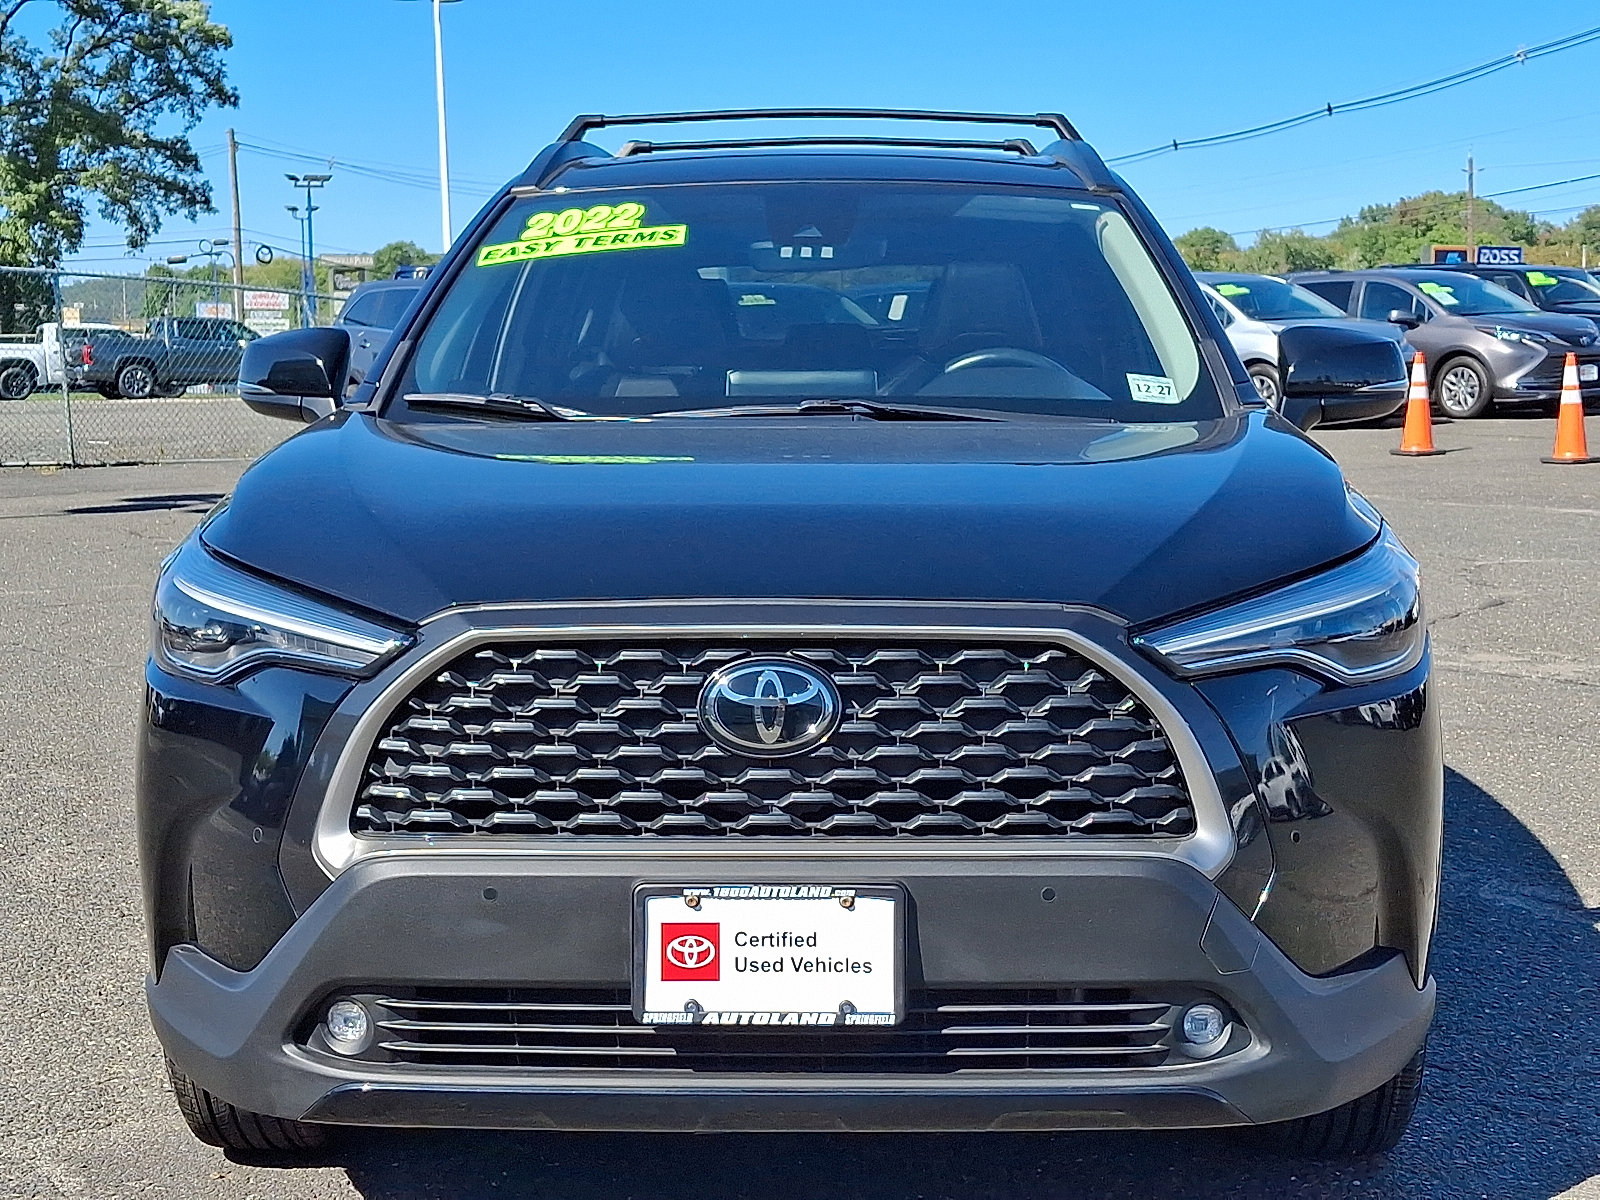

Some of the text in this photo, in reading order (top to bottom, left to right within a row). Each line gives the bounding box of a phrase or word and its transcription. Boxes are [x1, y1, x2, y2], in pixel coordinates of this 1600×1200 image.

[521, 202, 645, 241] 2022
[483, 229, 680, 261] EASY TERMS
[1479, 249, 1520, 264] ROSS
[1136, 383, 1171, 396] 12 27
[734, 931, 817, 948] Certified
[734, 957, 873, 974] Used Vehicles
[701, 1012, 837, 1026] AUTOLAND
[844, 1013, 896, 1025] SPRINGFIELD
